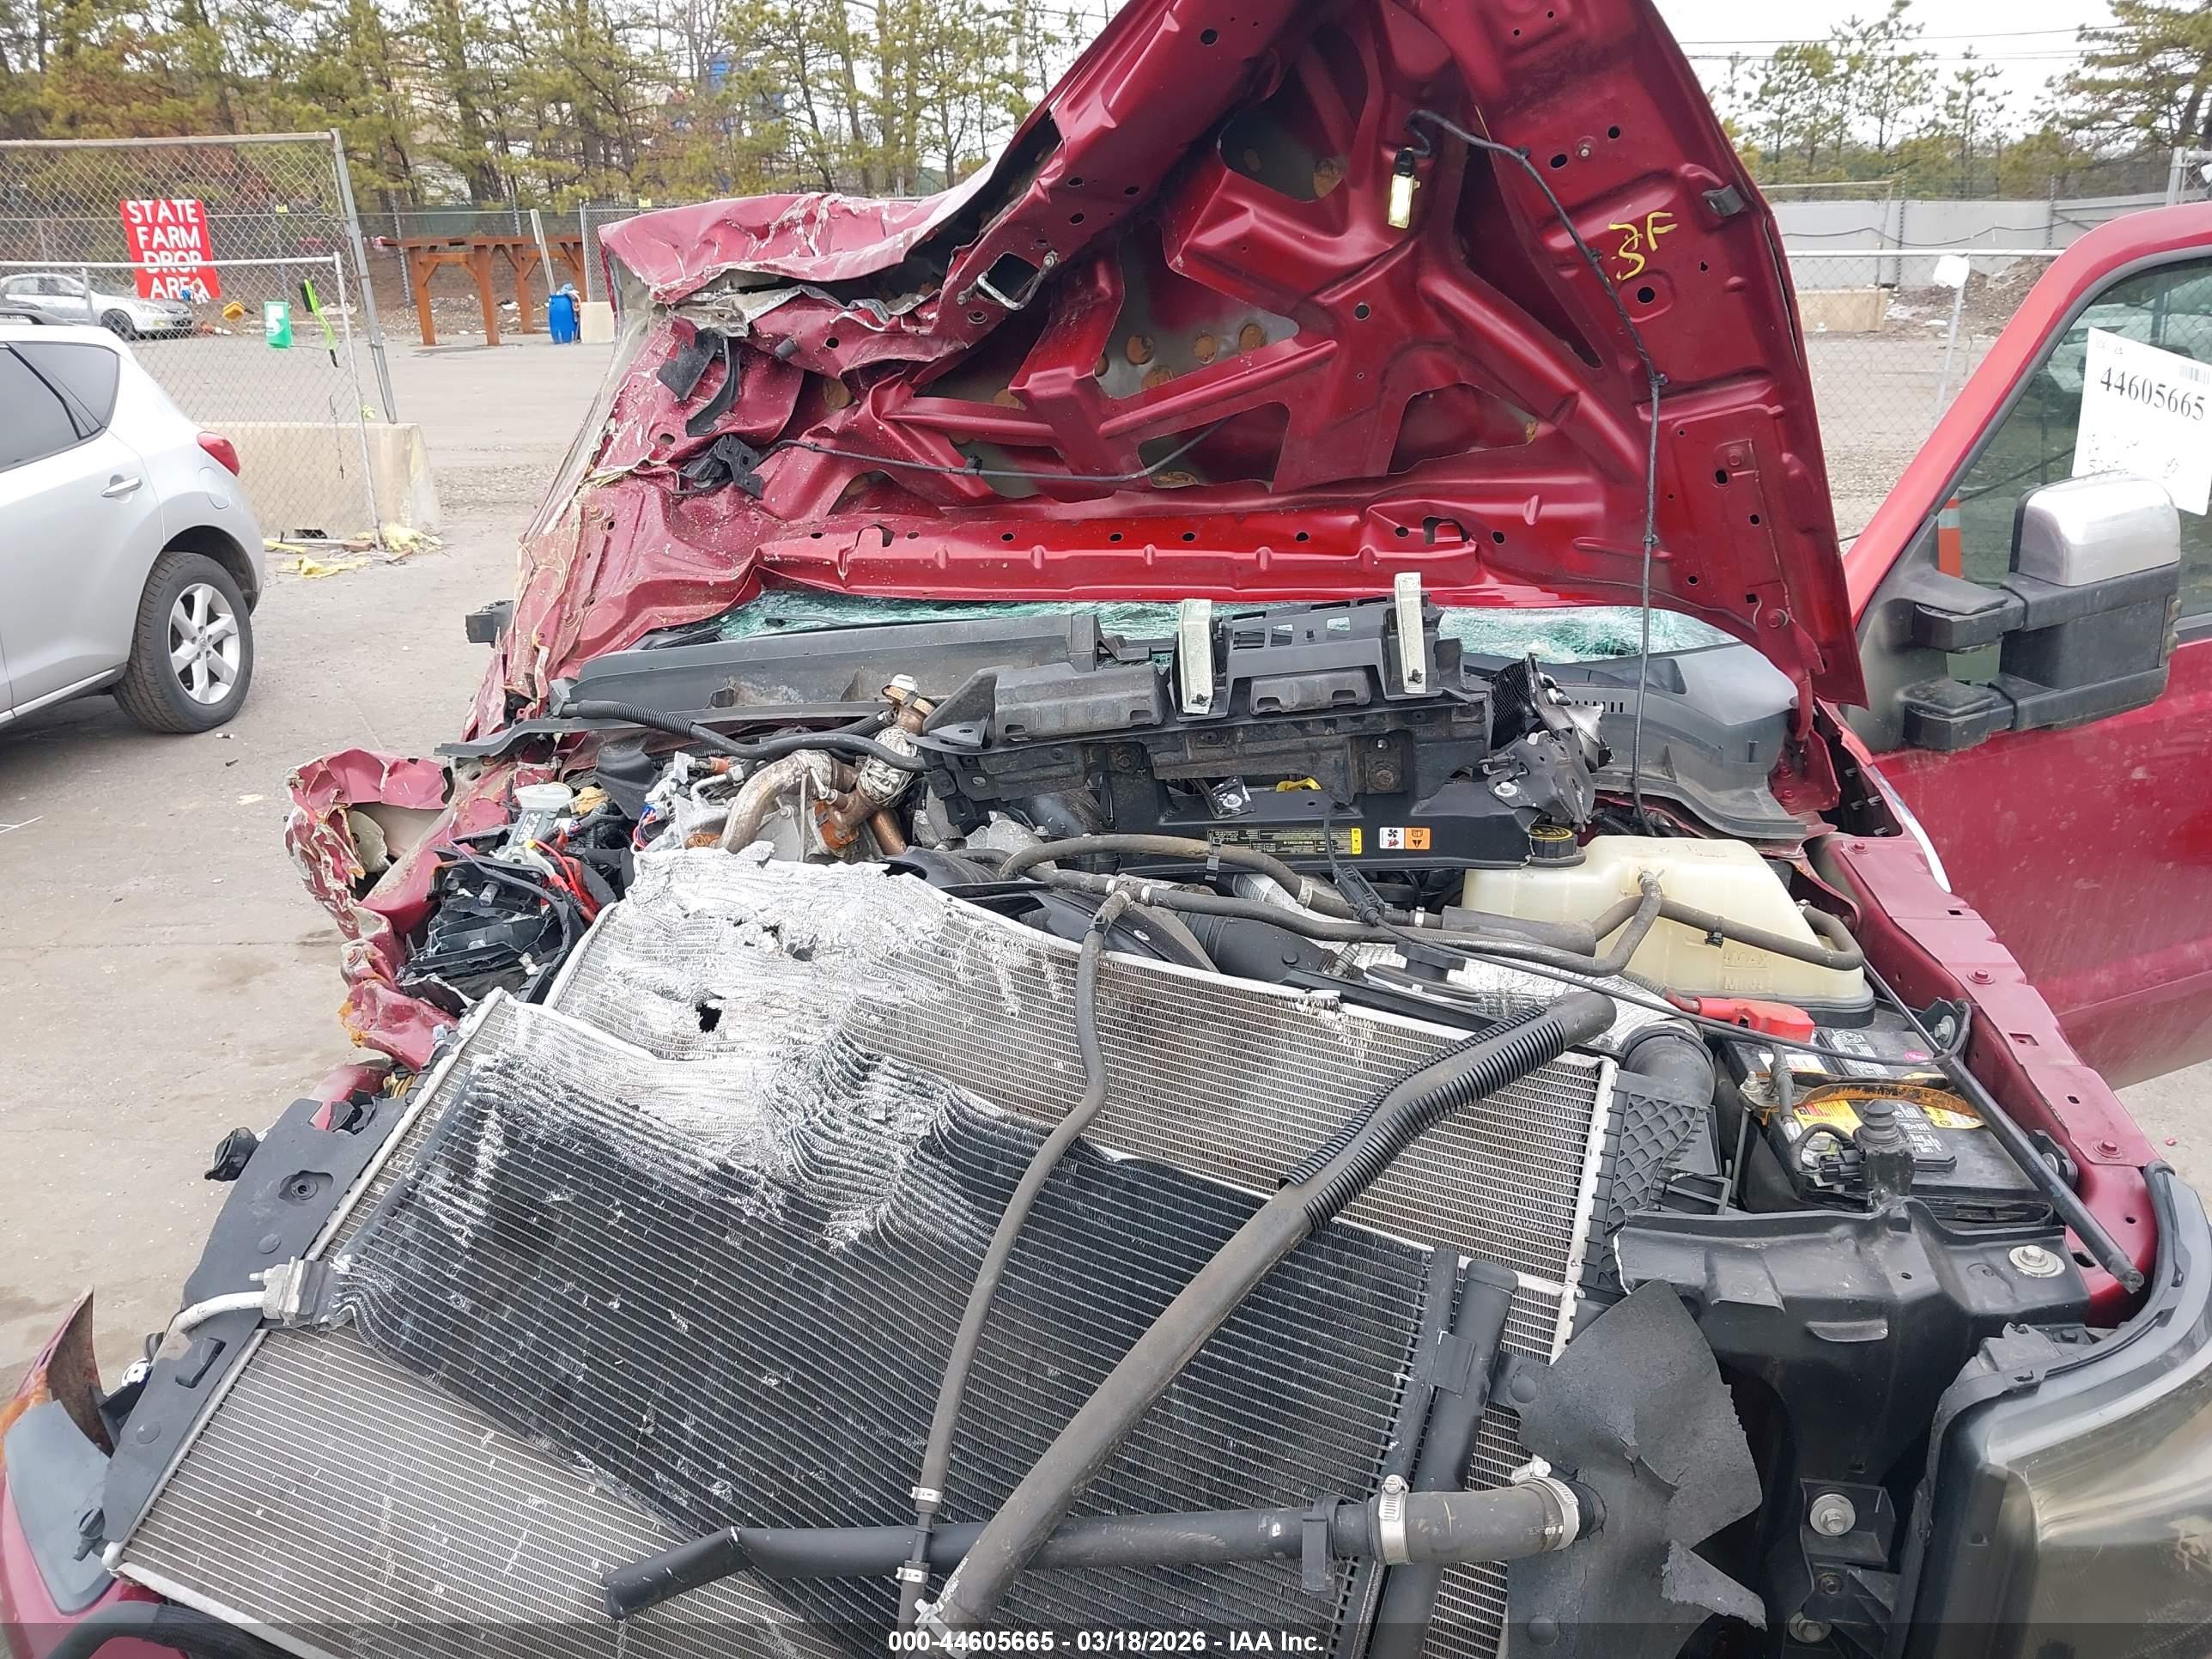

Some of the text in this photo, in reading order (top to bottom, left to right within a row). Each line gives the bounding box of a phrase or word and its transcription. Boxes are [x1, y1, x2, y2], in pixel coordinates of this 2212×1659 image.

[126, 199, 200, 223] STATE
[136, 225, 202, 249] FARM
[142, 250, 204, 274] DROP
[2100, 367, 2205, 421] 44605665
